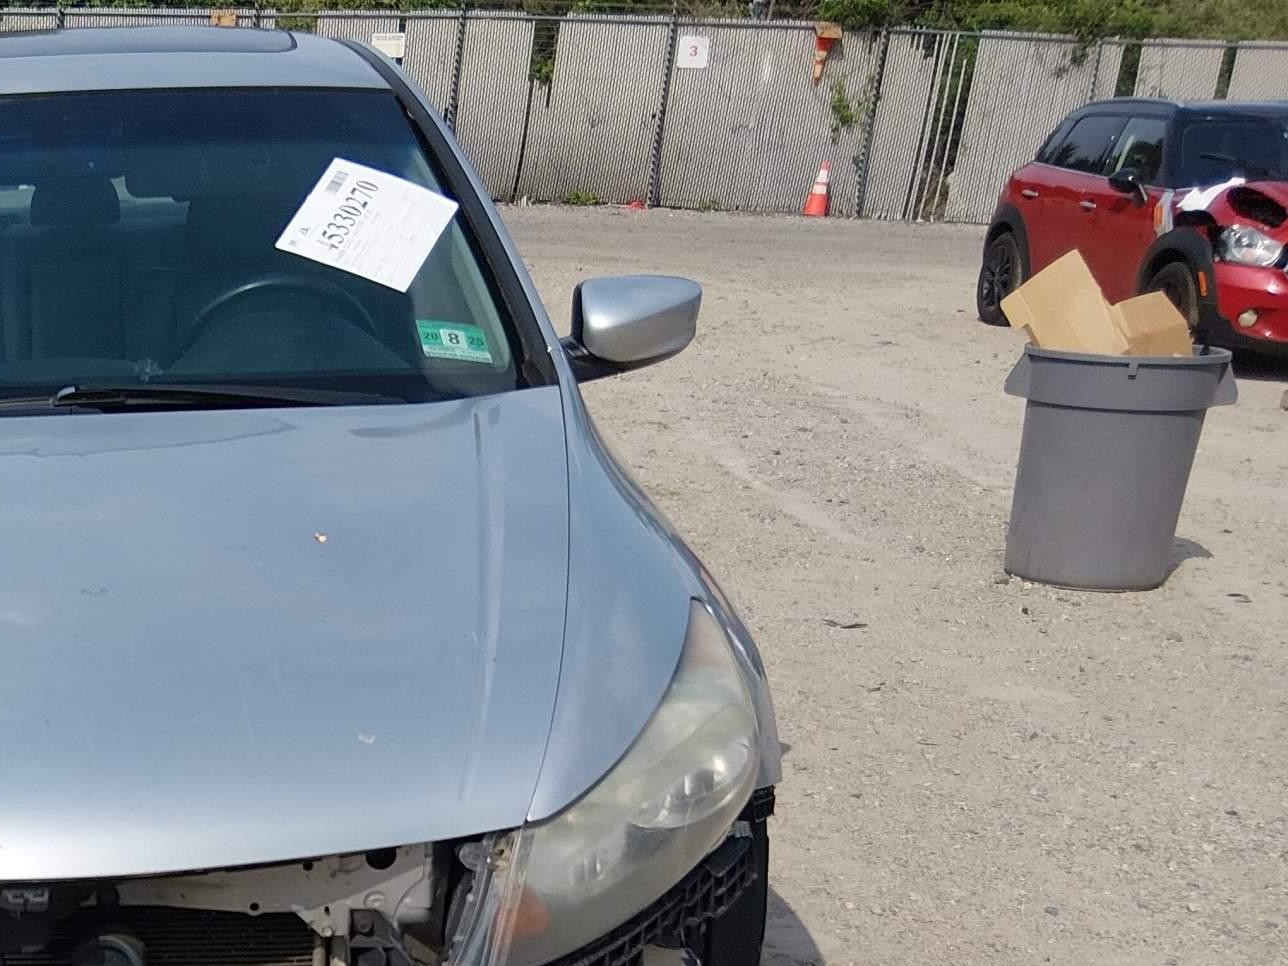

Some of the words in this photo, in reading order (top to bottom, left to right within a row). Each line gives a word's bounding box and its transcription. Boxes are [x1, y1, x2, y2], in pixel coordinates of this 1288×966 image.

[689, 45, 698, 57] 3
[316, 180, 379, 250] 45330270
[447, 332, 460, 345] 8
